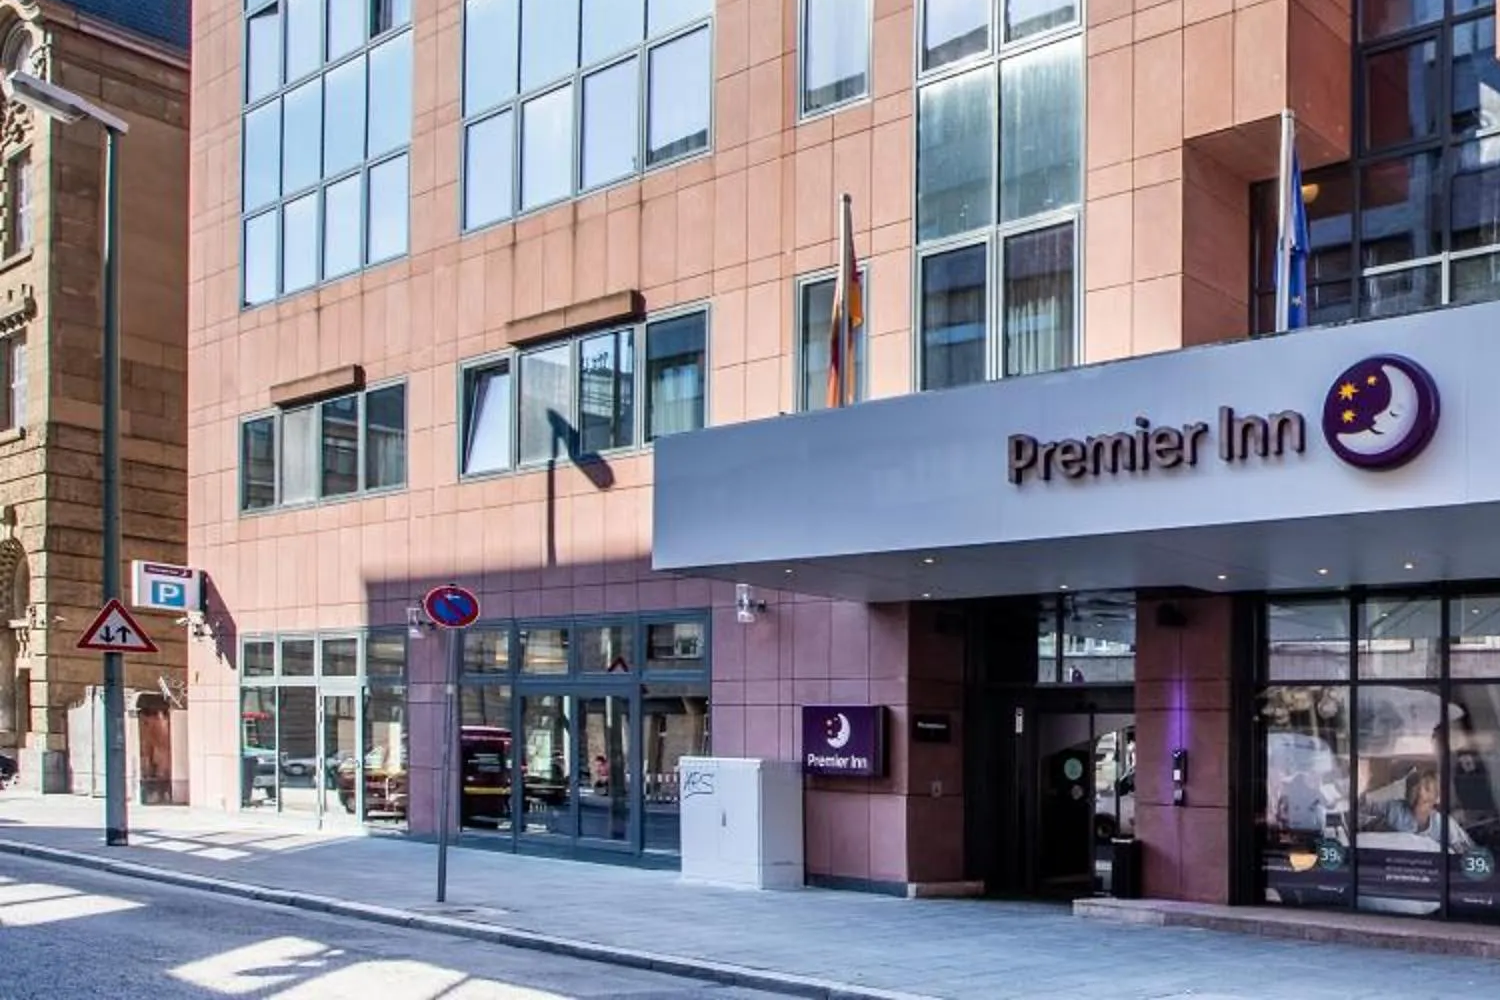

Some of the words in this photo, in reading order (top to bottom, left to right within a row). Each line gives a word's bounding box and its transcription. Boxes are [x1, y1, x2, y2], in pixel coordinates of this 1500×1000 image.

[1008, 416, 1208, 485] Premier
[1219, 405, 1306, 462] Inn
[159, 583, 180, 603] P
[807, 753, 849, 768] Premier
[852, 755, 868, 769] Inn
